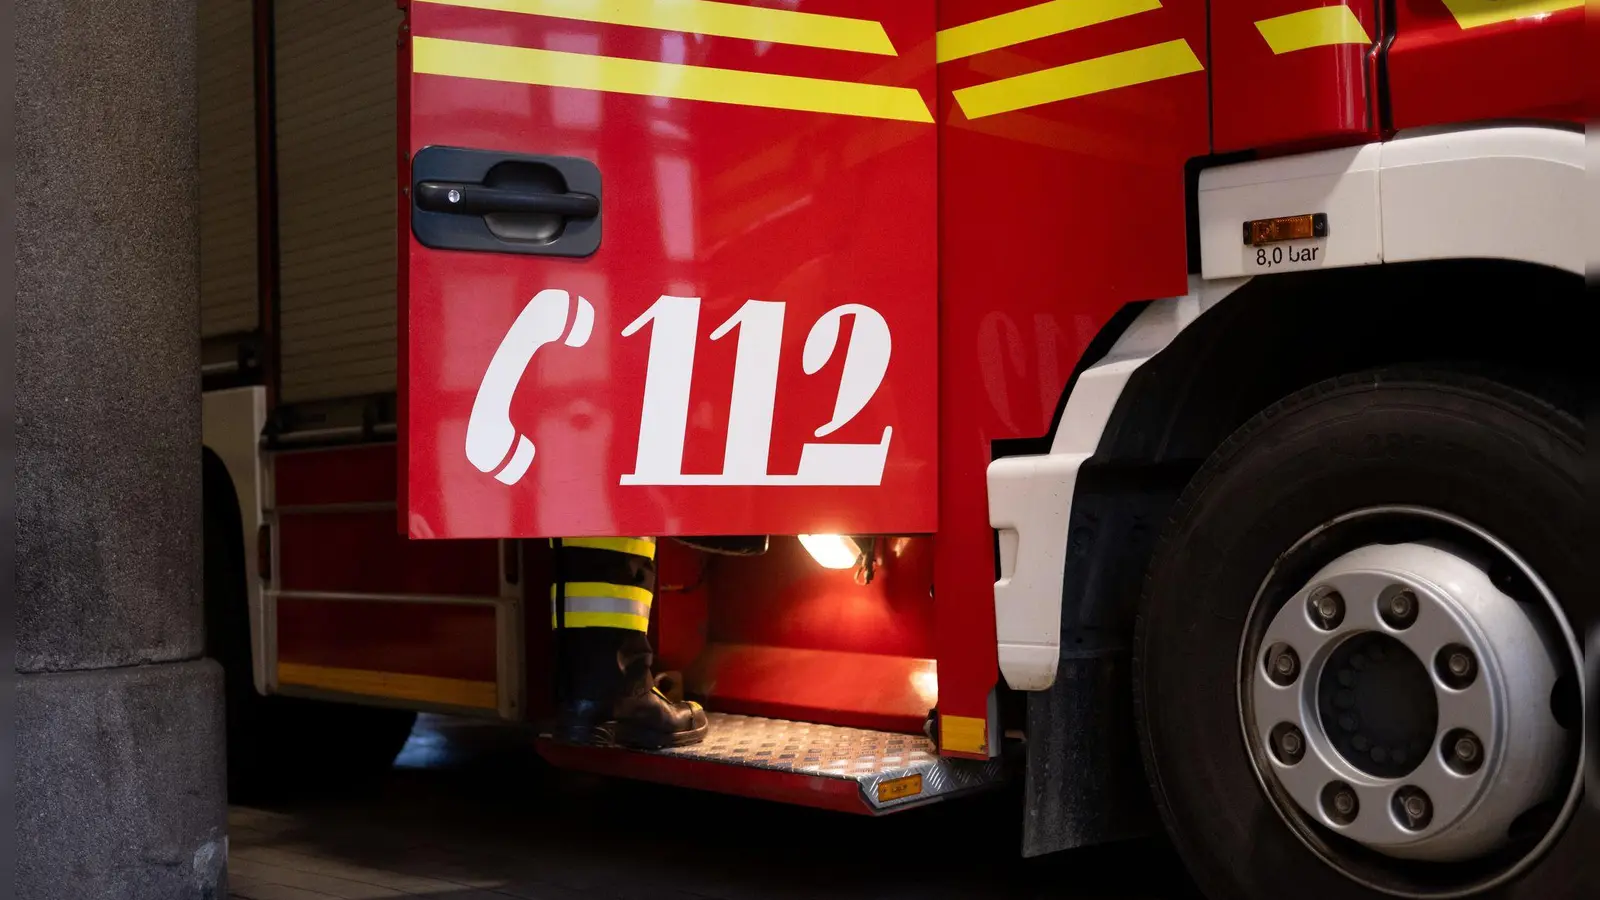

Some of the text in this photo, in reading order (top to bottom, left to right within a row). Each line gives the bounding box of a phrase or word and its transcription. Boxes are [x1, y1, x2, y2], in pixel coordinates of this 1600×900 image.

[1256, 246, 1319, 267] 8,0 bar
[620, 294, 893, 486] 112
